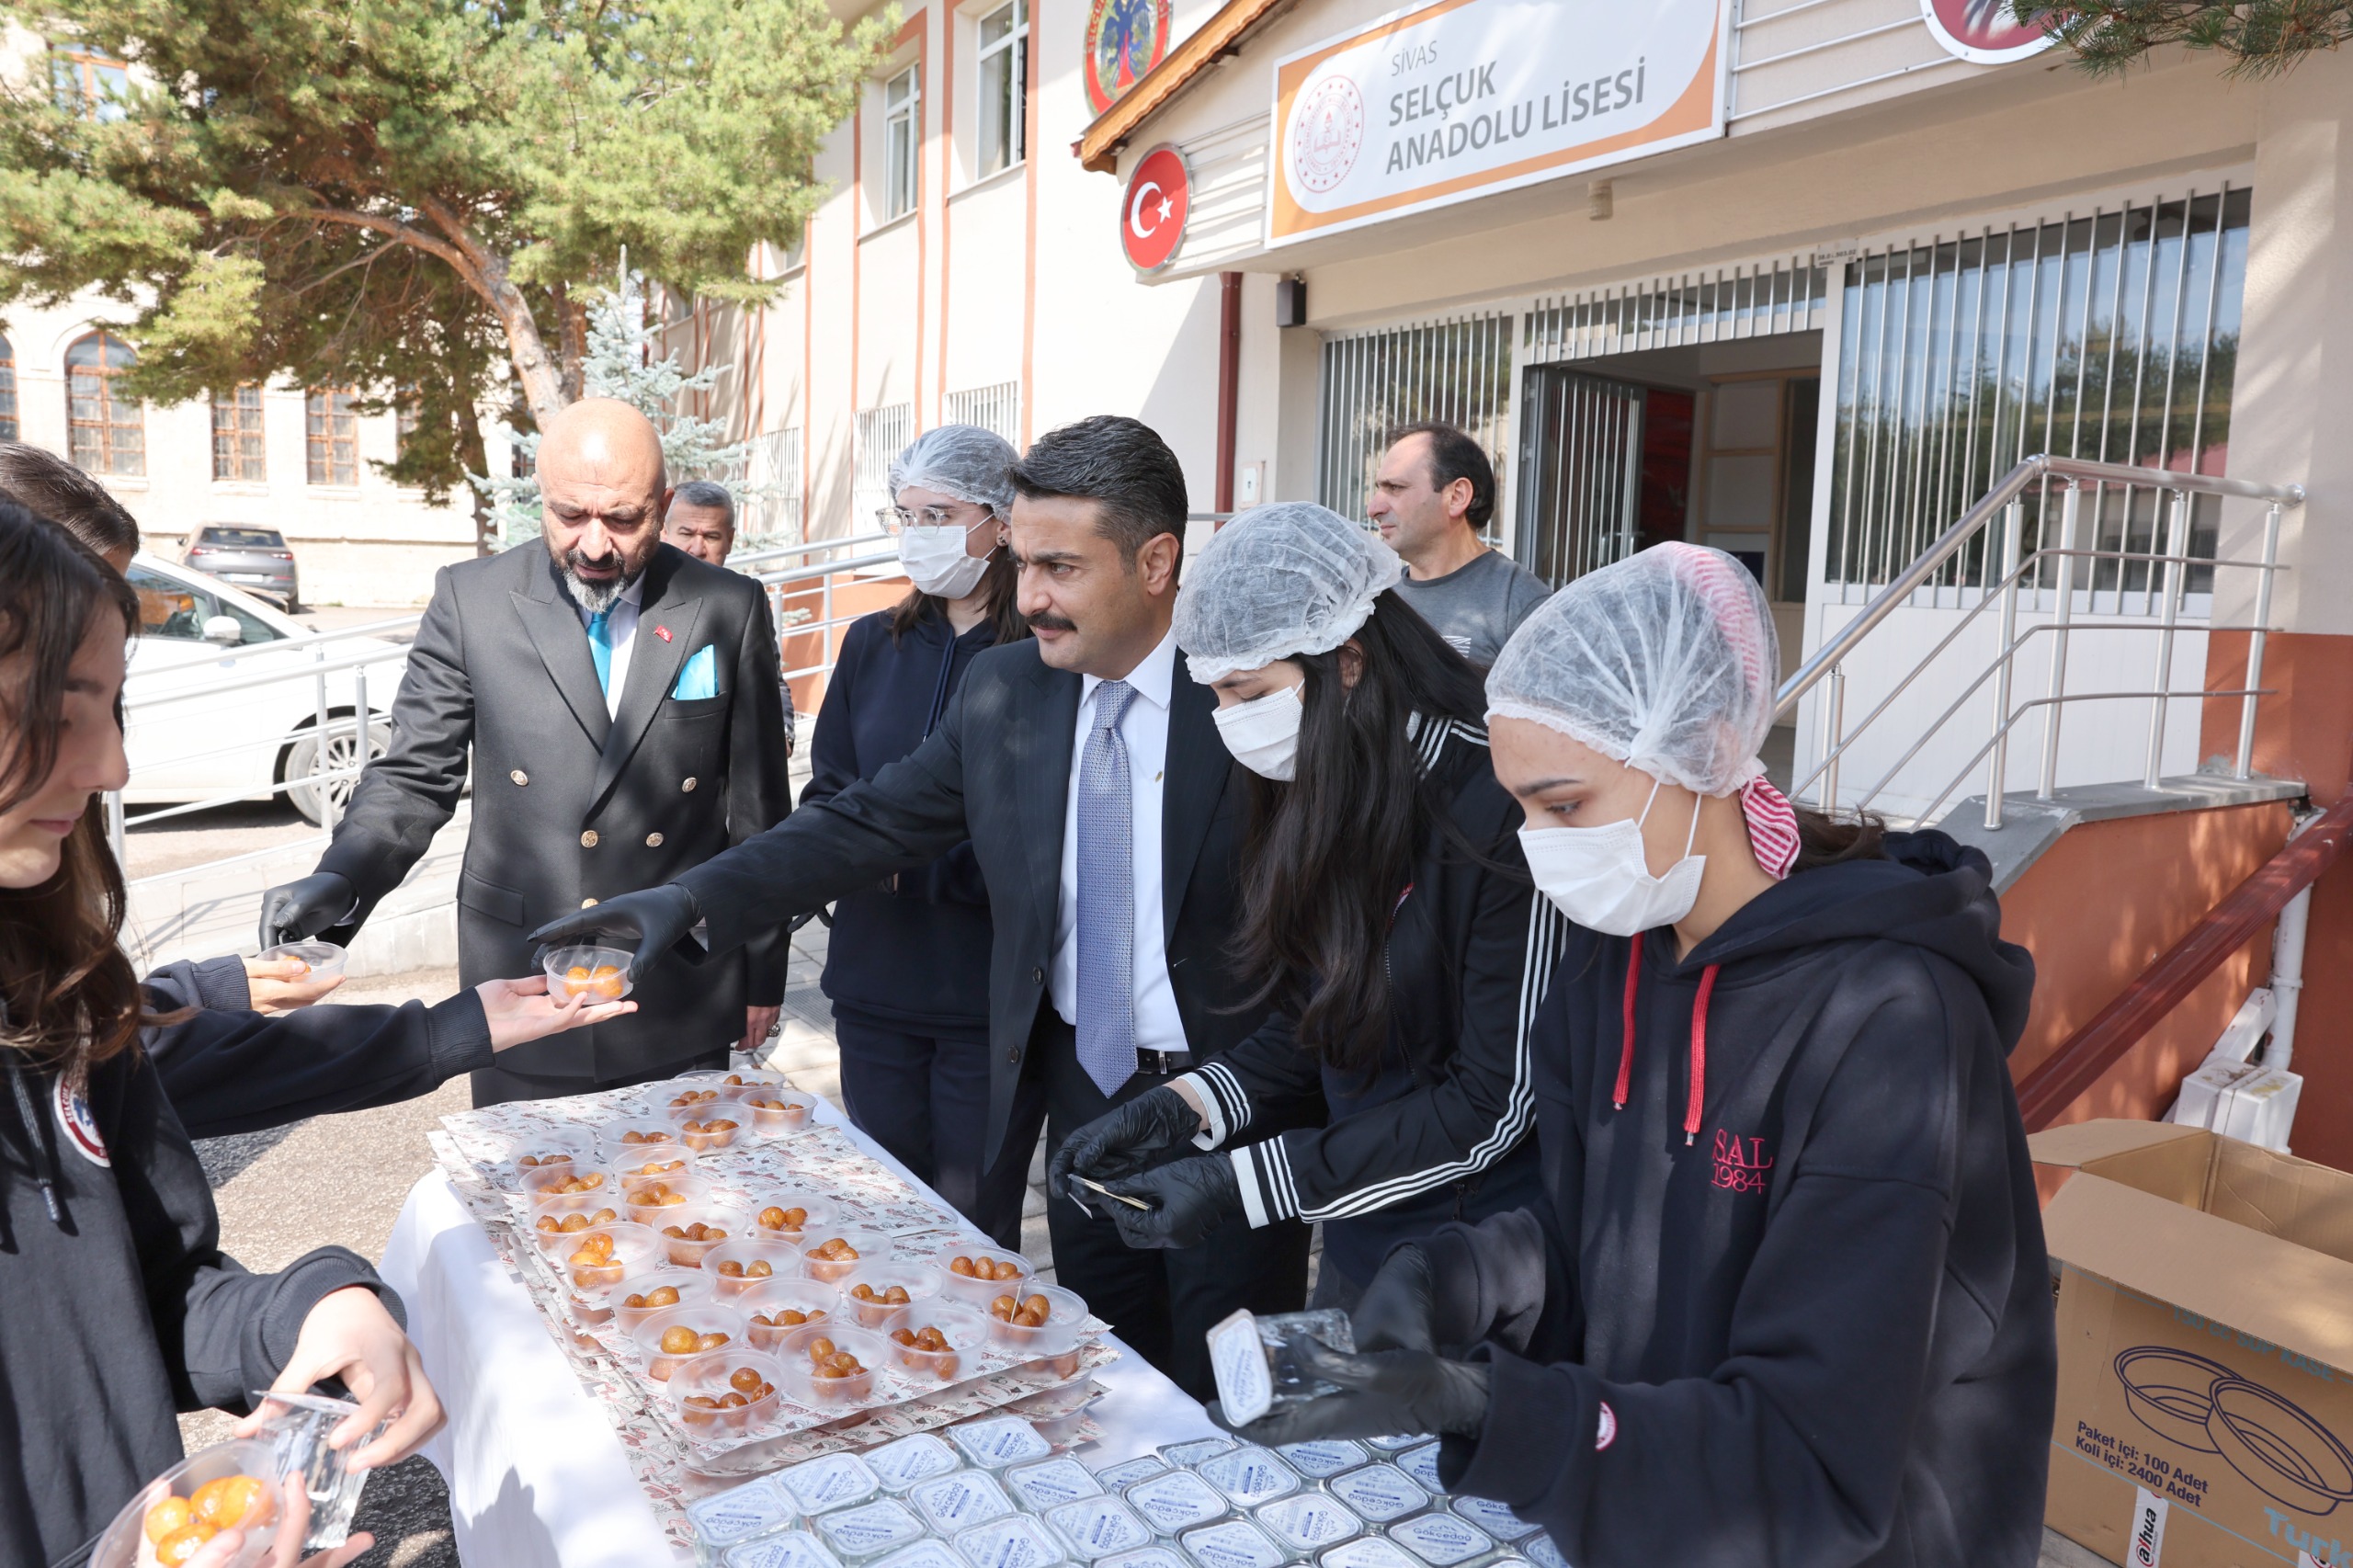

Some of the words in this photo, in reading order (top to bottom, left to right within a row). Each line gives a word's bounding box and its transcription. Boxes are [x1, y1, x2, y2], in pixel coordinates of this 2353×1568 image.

[1391, 40, 1438, 77] SİVAS
[1389, 60, 1497, 127] SELÇUK
[1385, 99, 1533, 175] ANADOLU
[1541, 55, 1645, 131] LİSESİ
[1711, 1128, 1773, 1169] SAL
[1711, 1163, 1767, 1195] 1984
[2172, 1305, 2206, 1330] 150
[2075, 1436, 2100, 1458] Koli
[2103, 1449, 2124, 1470] içi:
[2127, 1461, 2164, 1488] 2400
[2165, 1481, 2202, 1507] Adet
[2077, 1420, 2116, 1449] Paket
[2118, 1440, 2140, 1460] içi:
[2143, 1453, 2170, 1475] 100
[2173, 1467, 2209, 1494] Adet
[936, 1482, 964, 1518] Gökçedağ
[1143, 1502, 1201, 1518] Gökçedağ
[1348, 1493, 1404, 1509] Gökçedağ
[1476, 1499, 1510, 1512] Gökçe
[1414, 1527, 1472, 1542] Gökçedağ
